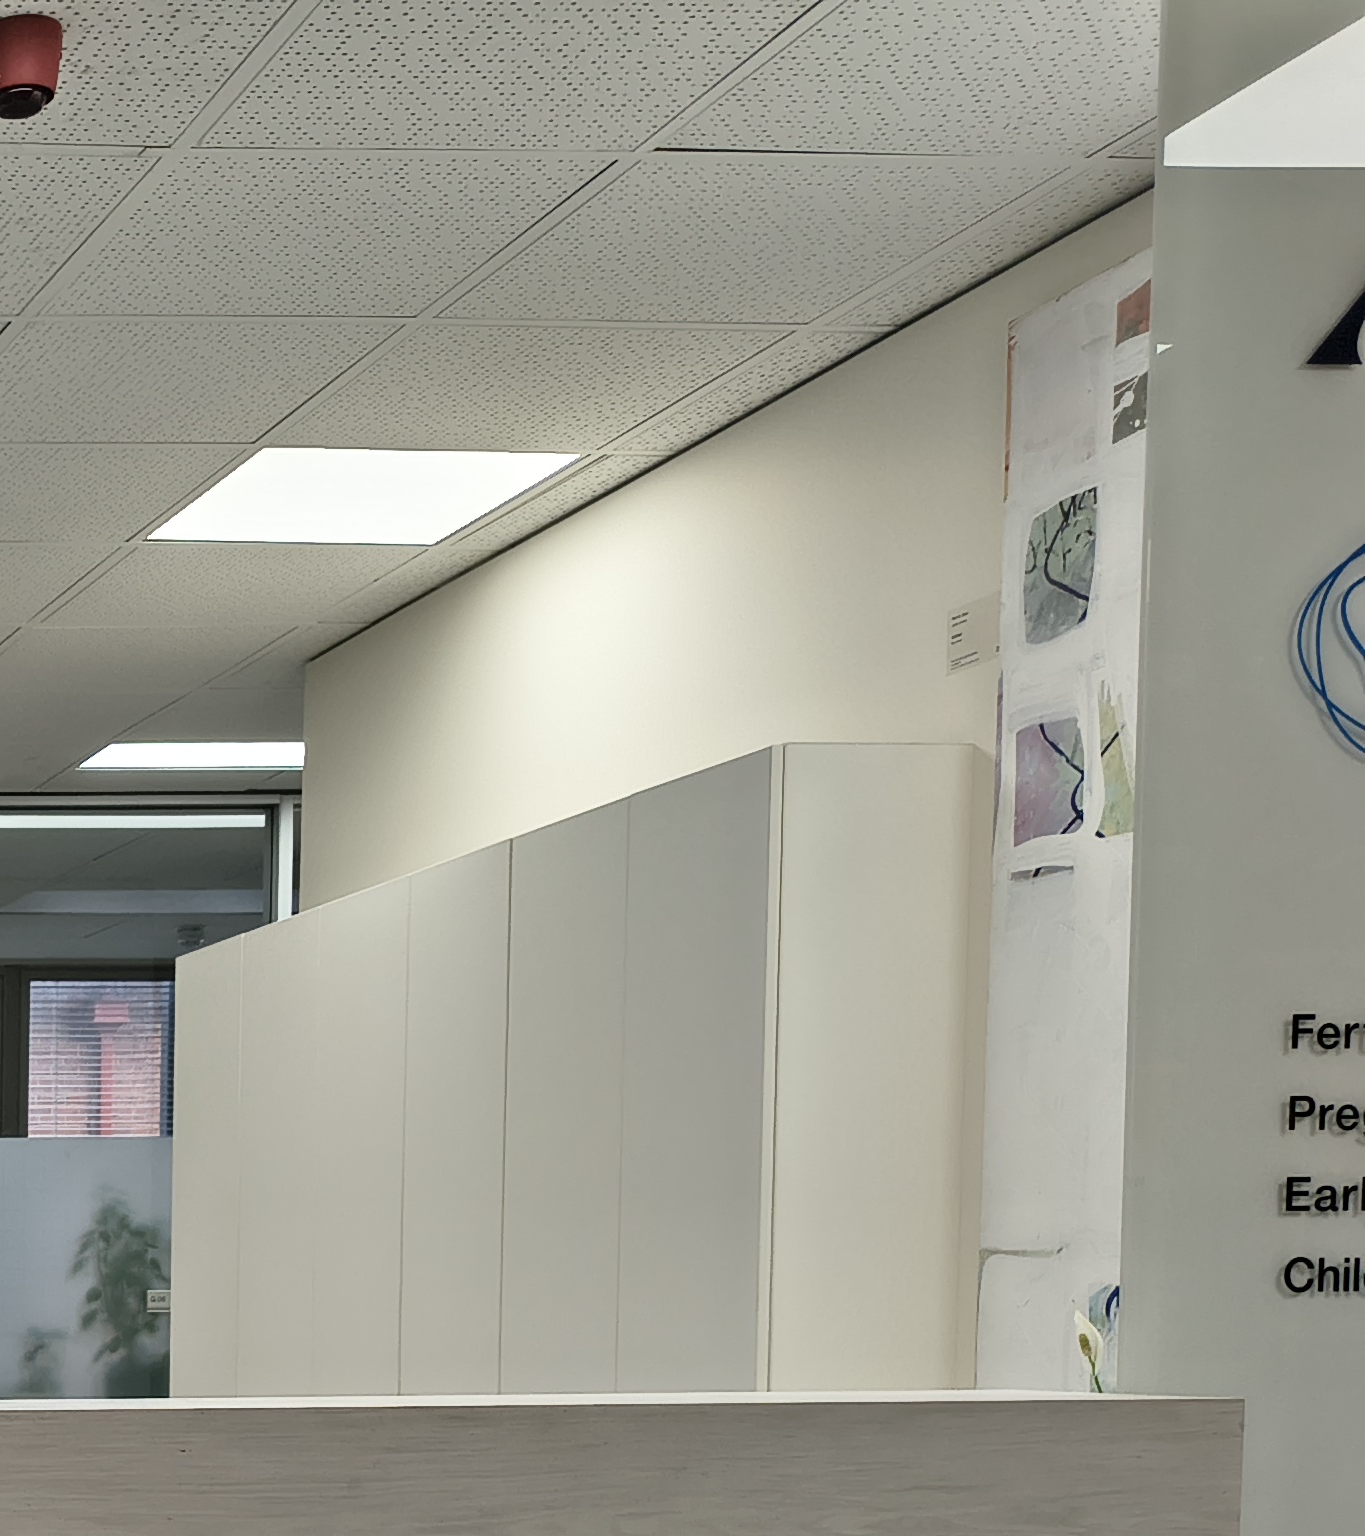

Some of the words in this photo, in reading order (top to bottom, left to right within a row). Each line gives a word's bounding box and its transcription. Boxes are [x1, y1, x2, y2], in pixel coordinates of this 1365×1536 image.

[1291, 1013, 1365, 1050] Fer
[1288, 1095, 1365, 1136] Pre
[1283, 1256, 1365, 1293] Chil
